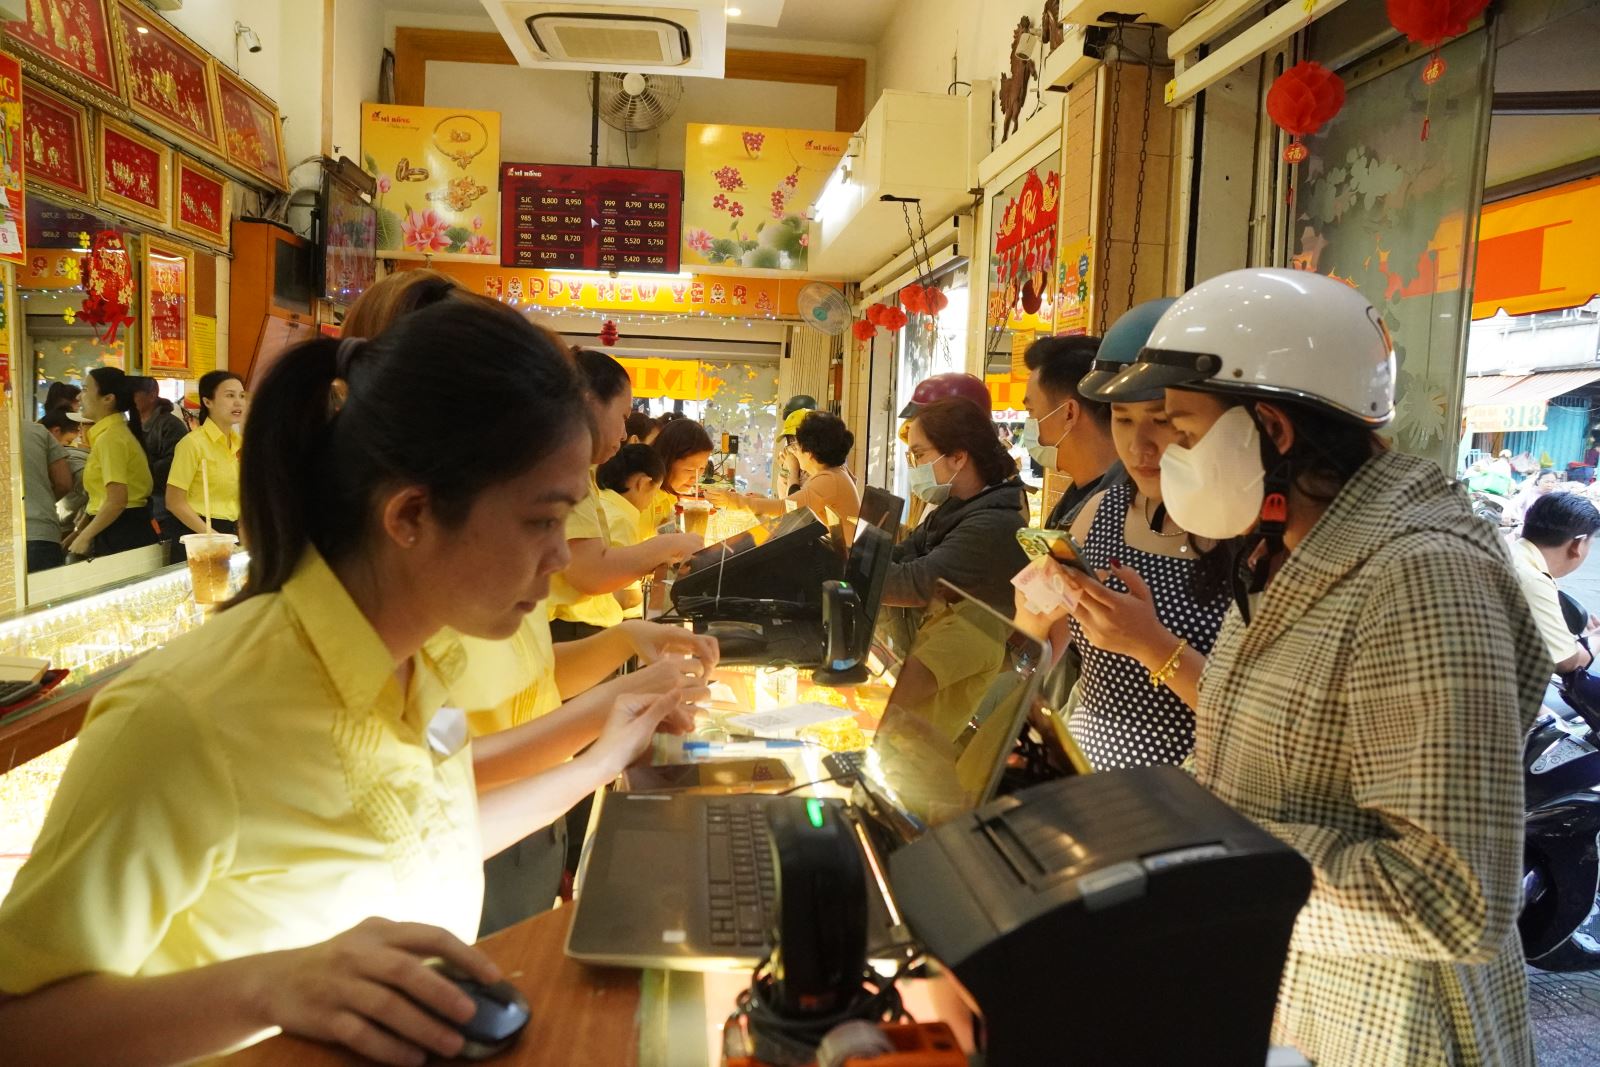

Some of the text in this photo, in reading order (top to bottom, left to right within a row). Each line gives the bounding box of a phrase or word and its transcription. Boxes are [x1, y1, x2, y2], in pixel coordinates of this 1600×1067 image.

[541, 197, 559, 205] 8,800
[565, 198, 582, 206] 8,950
[625, 201, 642, 209] 8,790
[648, 202, 665, 210] 8,950
[564, 216, 581, 224] 8,760
[648, 220, 665, 228] 6,550
[564, 234, 581, 242] 8,720
[624, 237, 641, 245] 5,520
[647, 238, 664, 246] 5,750
[540, 252, 557, 260] 8,270
[623, 255, 640, 263] 5,420
[594, 279, 658, 303] NEW
[671, 281, 748, 306] YEAR
